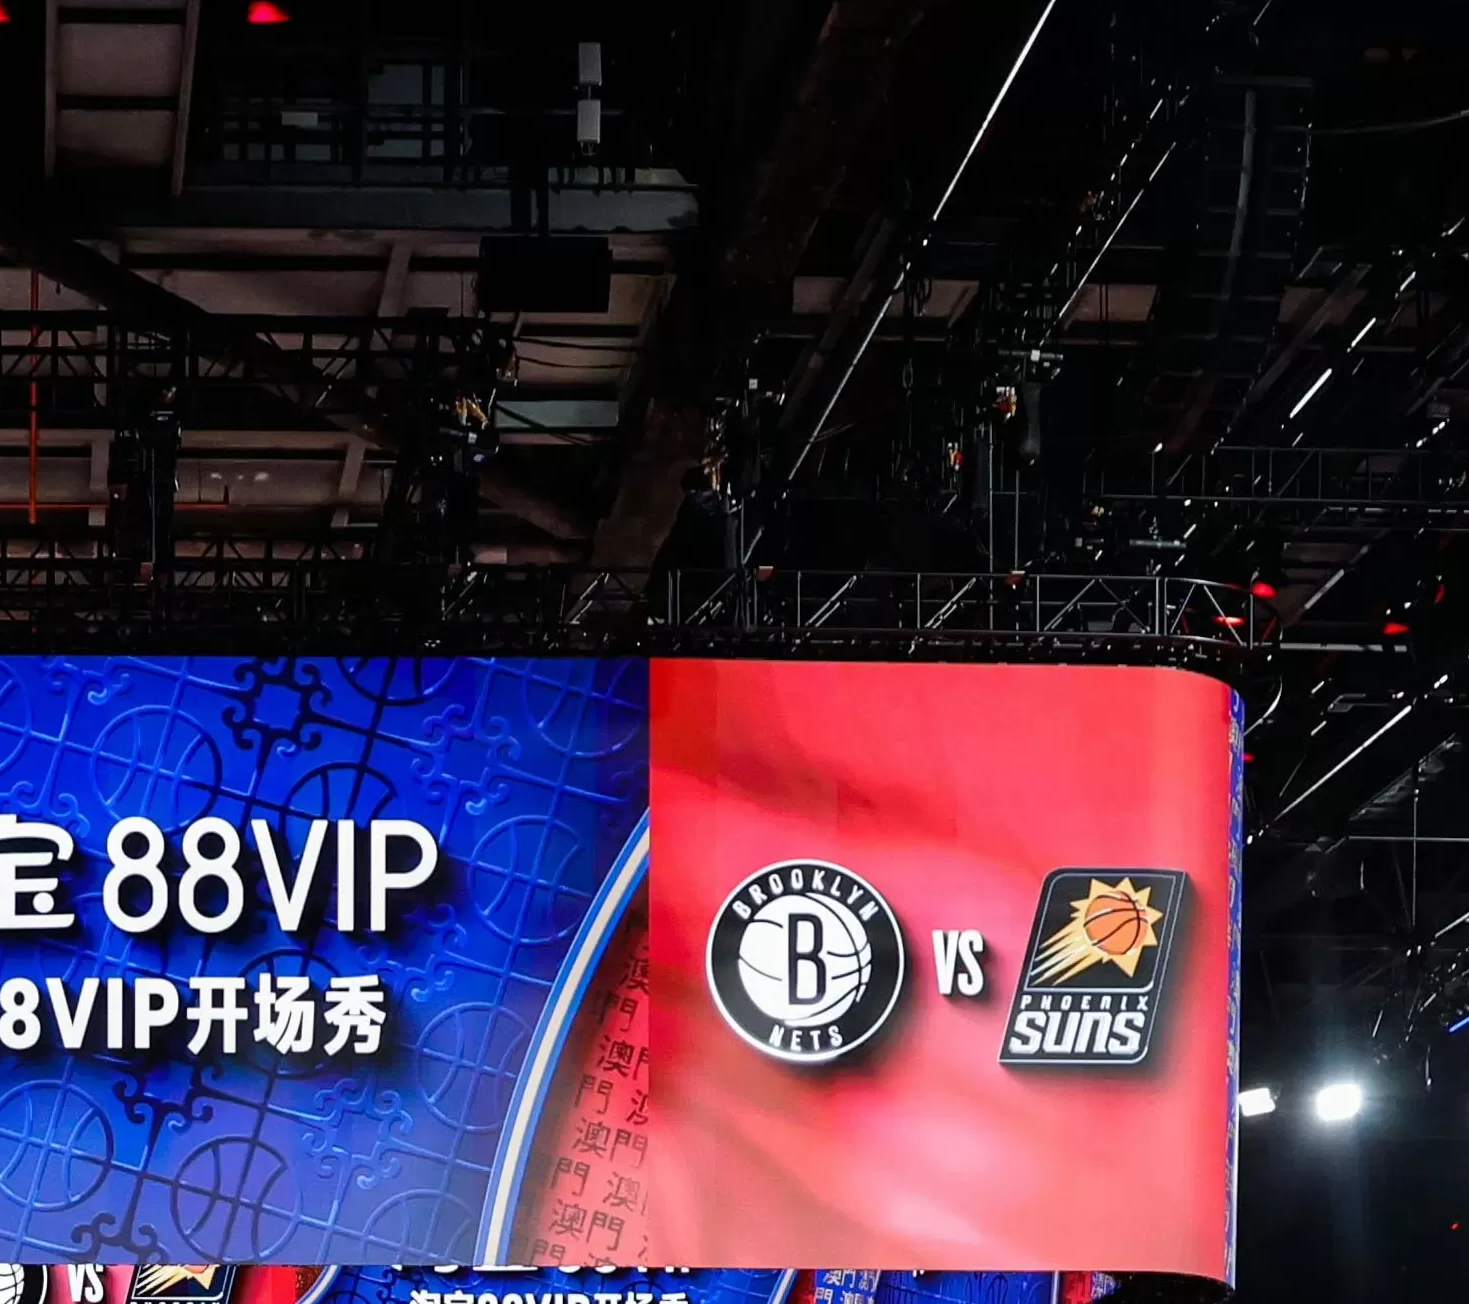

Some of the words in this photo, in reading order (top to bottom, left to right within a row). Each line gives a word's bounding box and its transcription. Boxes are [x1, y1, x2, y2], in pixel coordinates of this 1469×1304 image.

[733, 868, 880, 921] BROOKLYN
[932, 929, 984, 996] VS
[1020, 994, 1149, 1012] PHOENIX
[768, 1025, 844, 1052] NETS
[1009, 1010, 1145, 1055] SUNS
